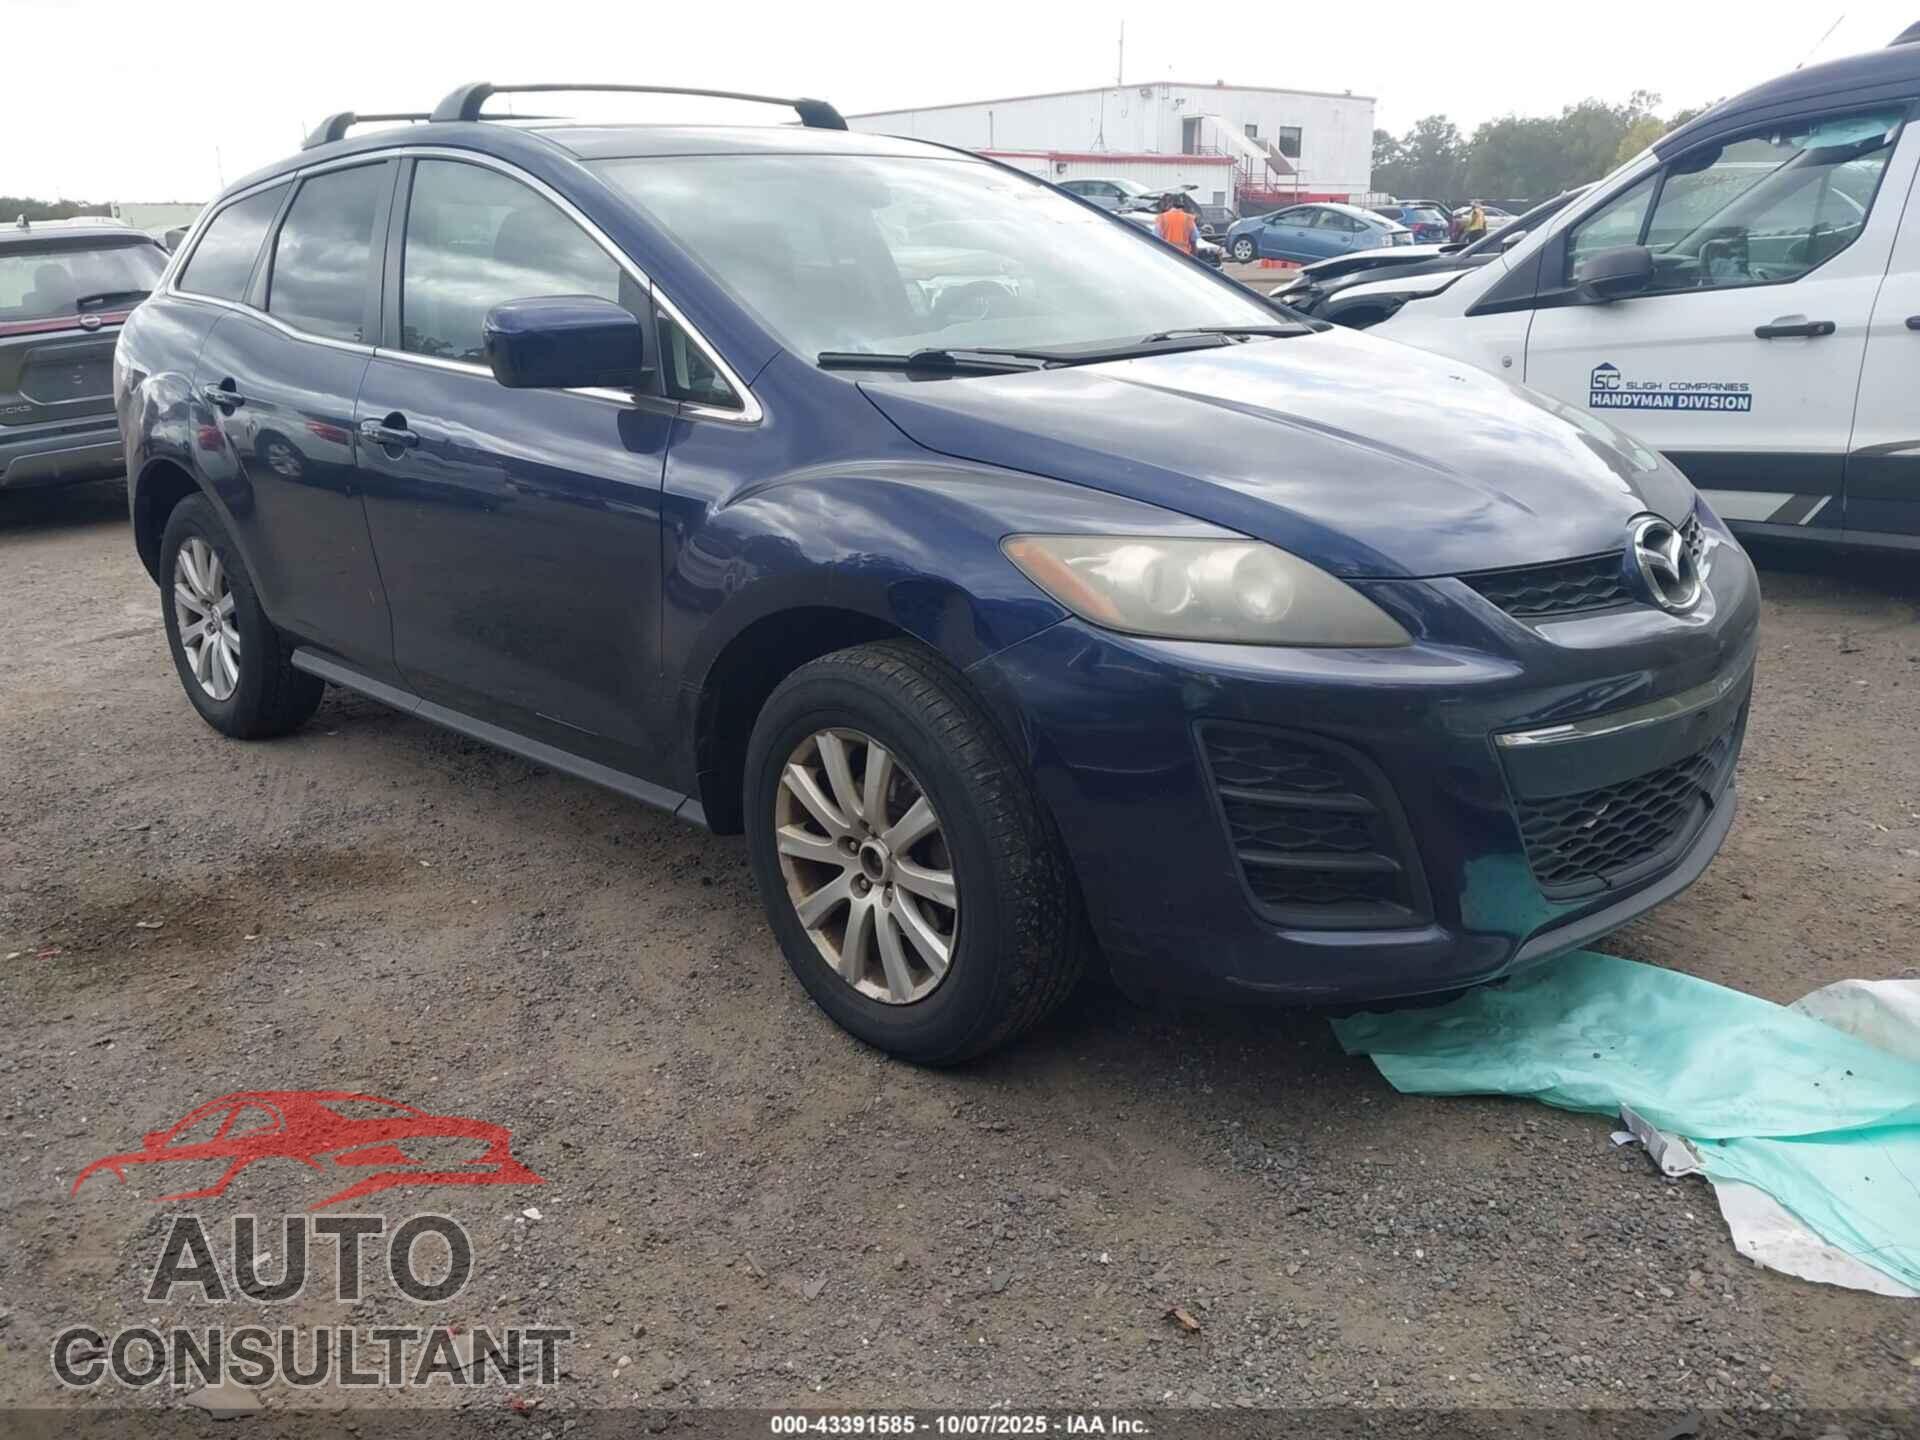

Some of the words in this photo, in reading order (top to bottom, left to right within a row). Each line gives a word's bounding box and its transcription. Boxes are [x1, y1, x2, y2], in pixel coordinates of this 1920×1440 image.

[1626, 382, 1662, 390] SLIGH
[1669, 382, 1749, 392] COMPANIES
[1591, 393, 1674, 408] HANDYMAN
[1677, 395, 1749, 410] DIVISION
